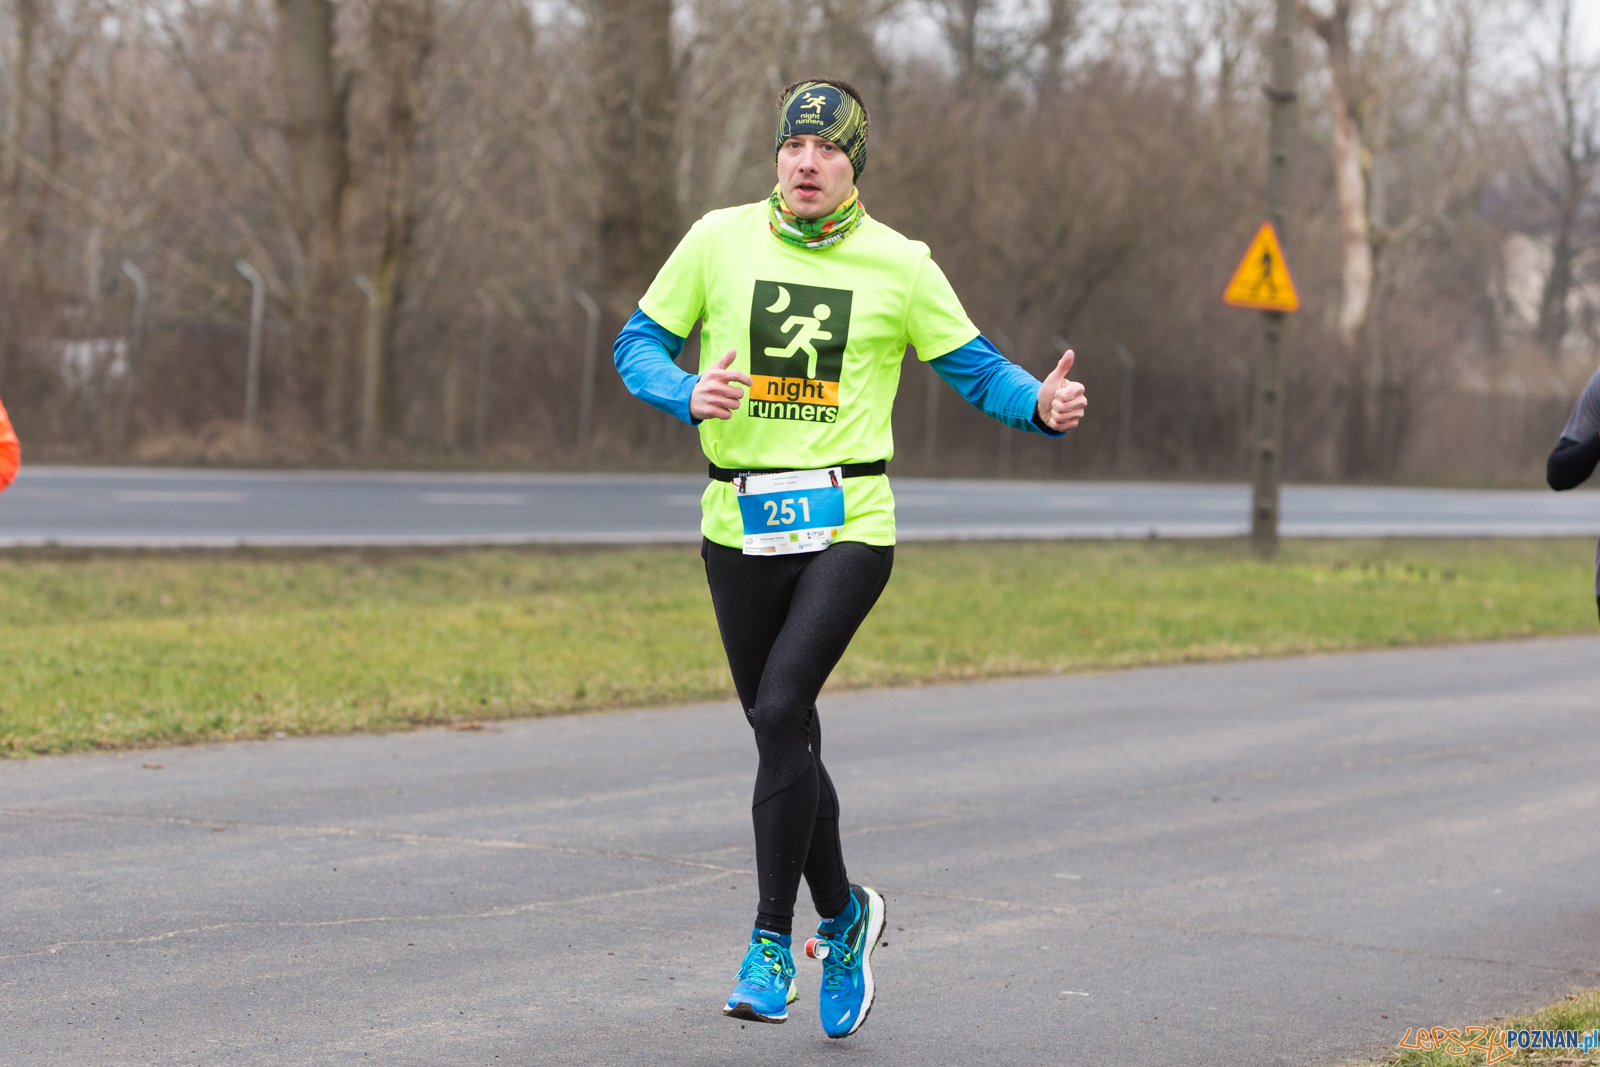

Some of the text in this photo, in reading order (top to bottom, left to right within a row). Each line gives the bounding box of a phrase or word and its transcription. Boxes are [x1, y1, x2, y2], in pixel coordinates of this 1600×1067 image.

[767, 377, 824, 401] night
[749, 400, 838, 423] runners
[763, 497, 811, 526] 251
